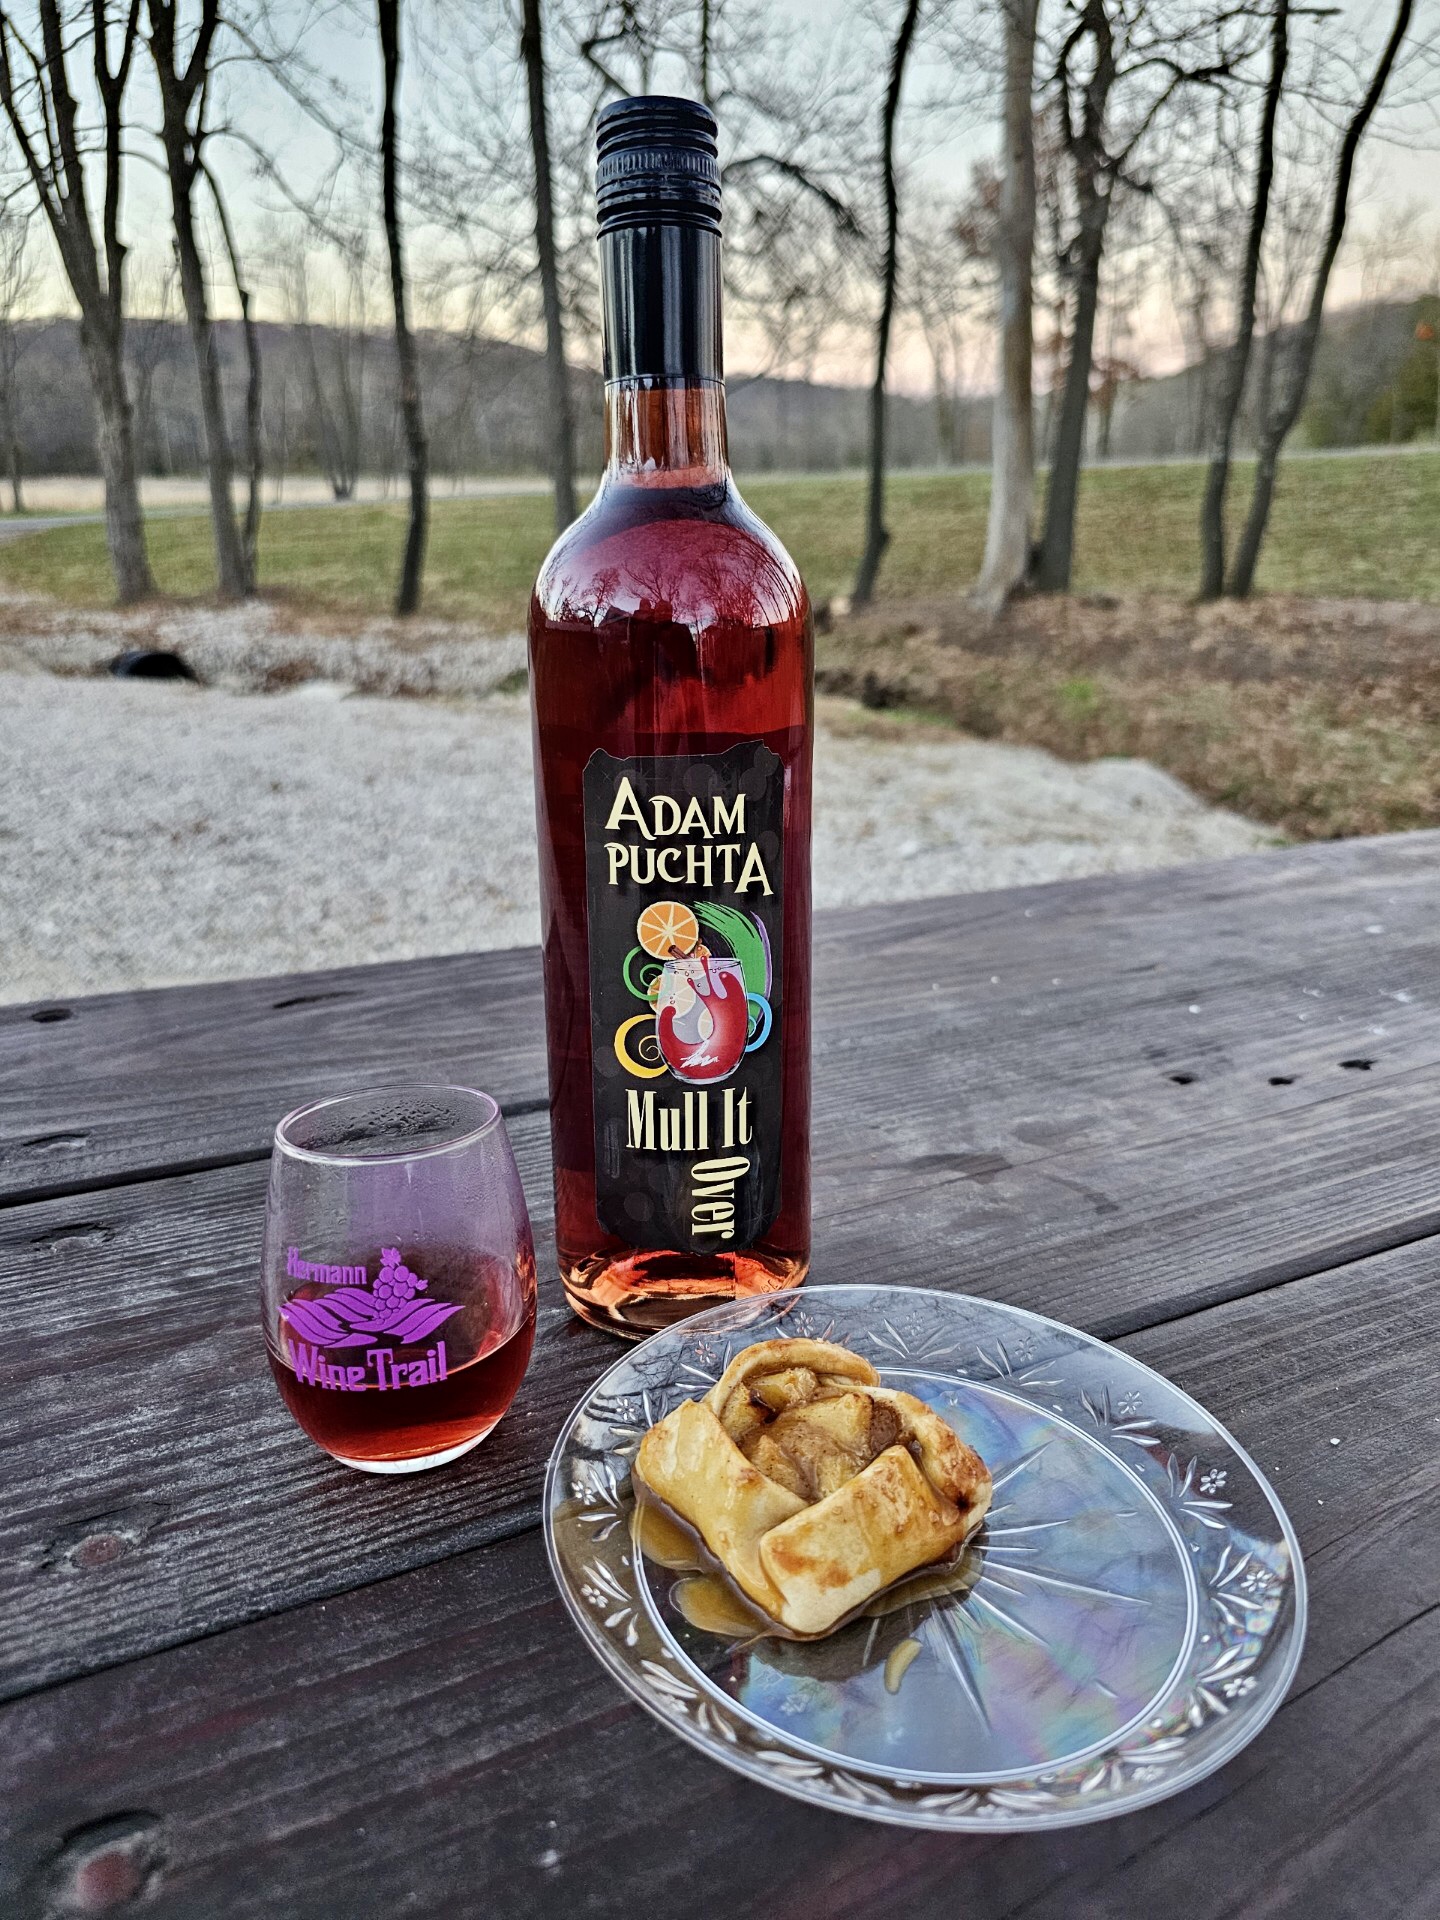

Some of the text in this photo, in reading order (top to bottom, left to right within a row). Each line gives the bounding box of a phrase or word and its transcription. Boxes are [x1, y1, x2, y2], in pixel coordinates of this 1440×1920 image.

[605, 777, 746, 840] ADAM
[604, 842, 774, 896] PUCHTA
[625, 1086, 753, 1151] Mull It
[691, 1156, 750, 1239] Over
[287, 1247, 367, 1285] Hermann
[289, 1339, 447, 1392] Wine Trail
